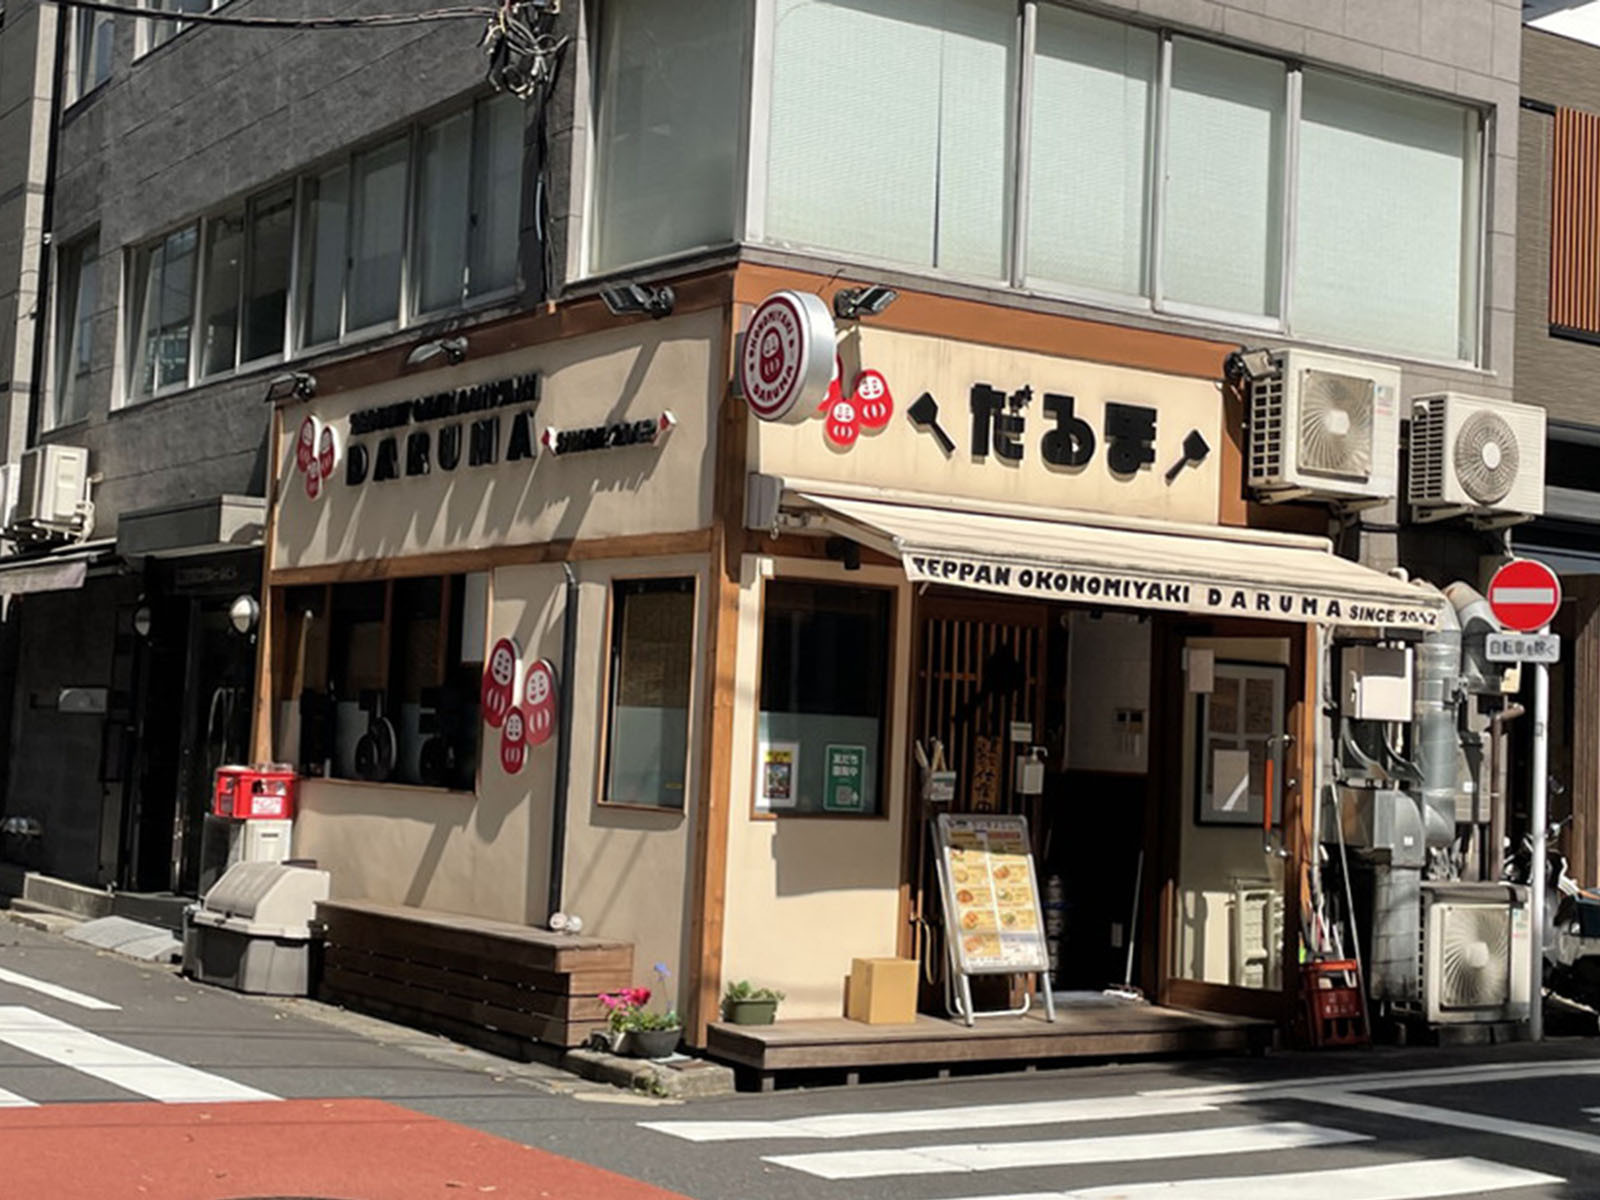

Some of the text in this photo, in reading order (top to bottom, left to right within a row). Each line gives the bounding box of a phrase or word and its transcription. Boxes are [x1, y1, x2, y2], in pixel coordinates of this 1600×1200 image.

[345, 410, 537, 486] DARUMA
[970, 383, 1158, 475] だるま
[912, 556, 1011, 586] TEPPAN
[1018, 569, 1190, 603] OKONOMIYAKI
[1208, 588, 1342, 618] DARUMA
[1350, 605, 1395, 622] SINCE
